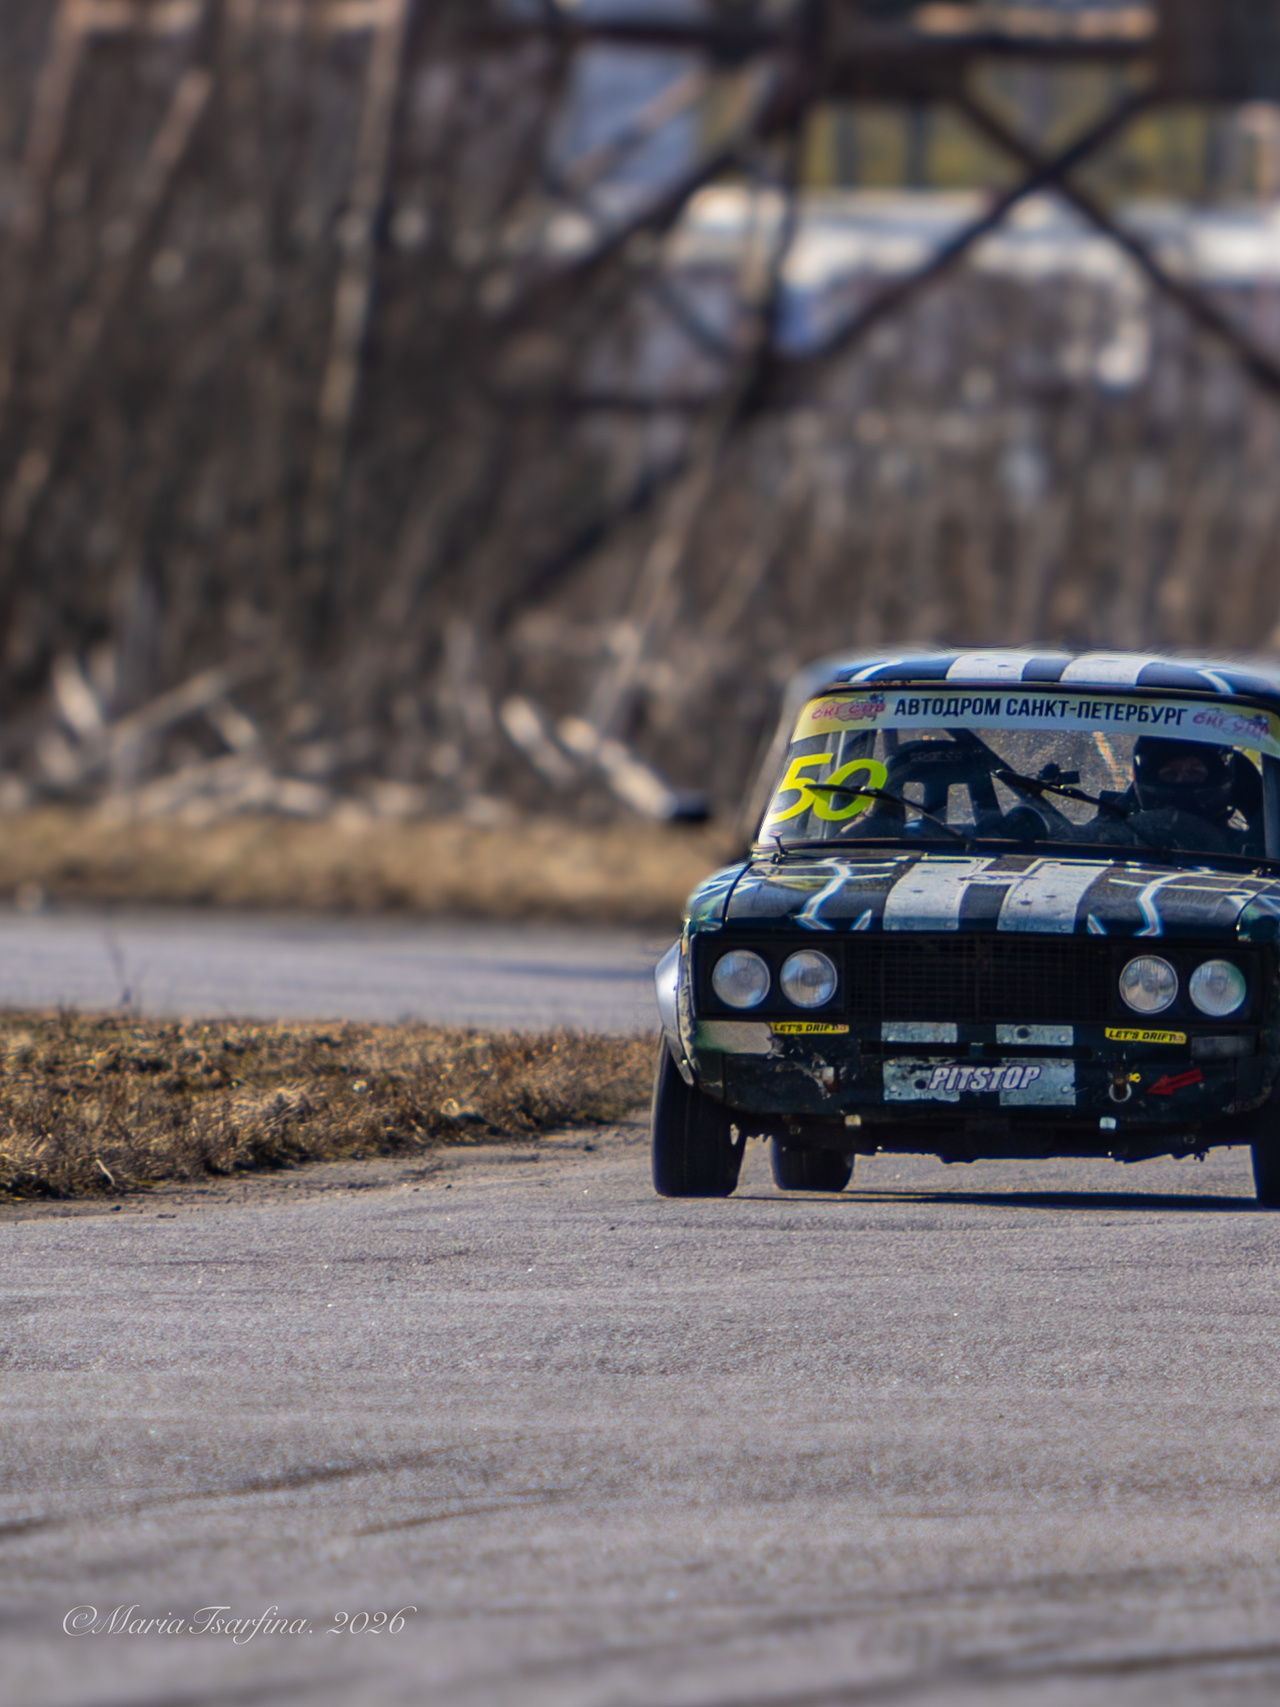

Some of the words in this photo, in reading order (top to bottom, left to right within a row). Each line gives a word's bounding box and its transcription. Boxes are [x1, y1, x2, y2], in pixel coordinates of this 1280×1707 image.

[894, 697, 1001, 716] АВТОДРОМ
[1005, 699, 1188, 726] САНКТ-ПЕТЕРБУРГ
[767, 753, 888, 824] 50
[773, 1023, 803, 1033] LET'S
[1108, 1029, 1140, 1040] LET'S
[928, 1064, 1042, 1092] PITSTOP
